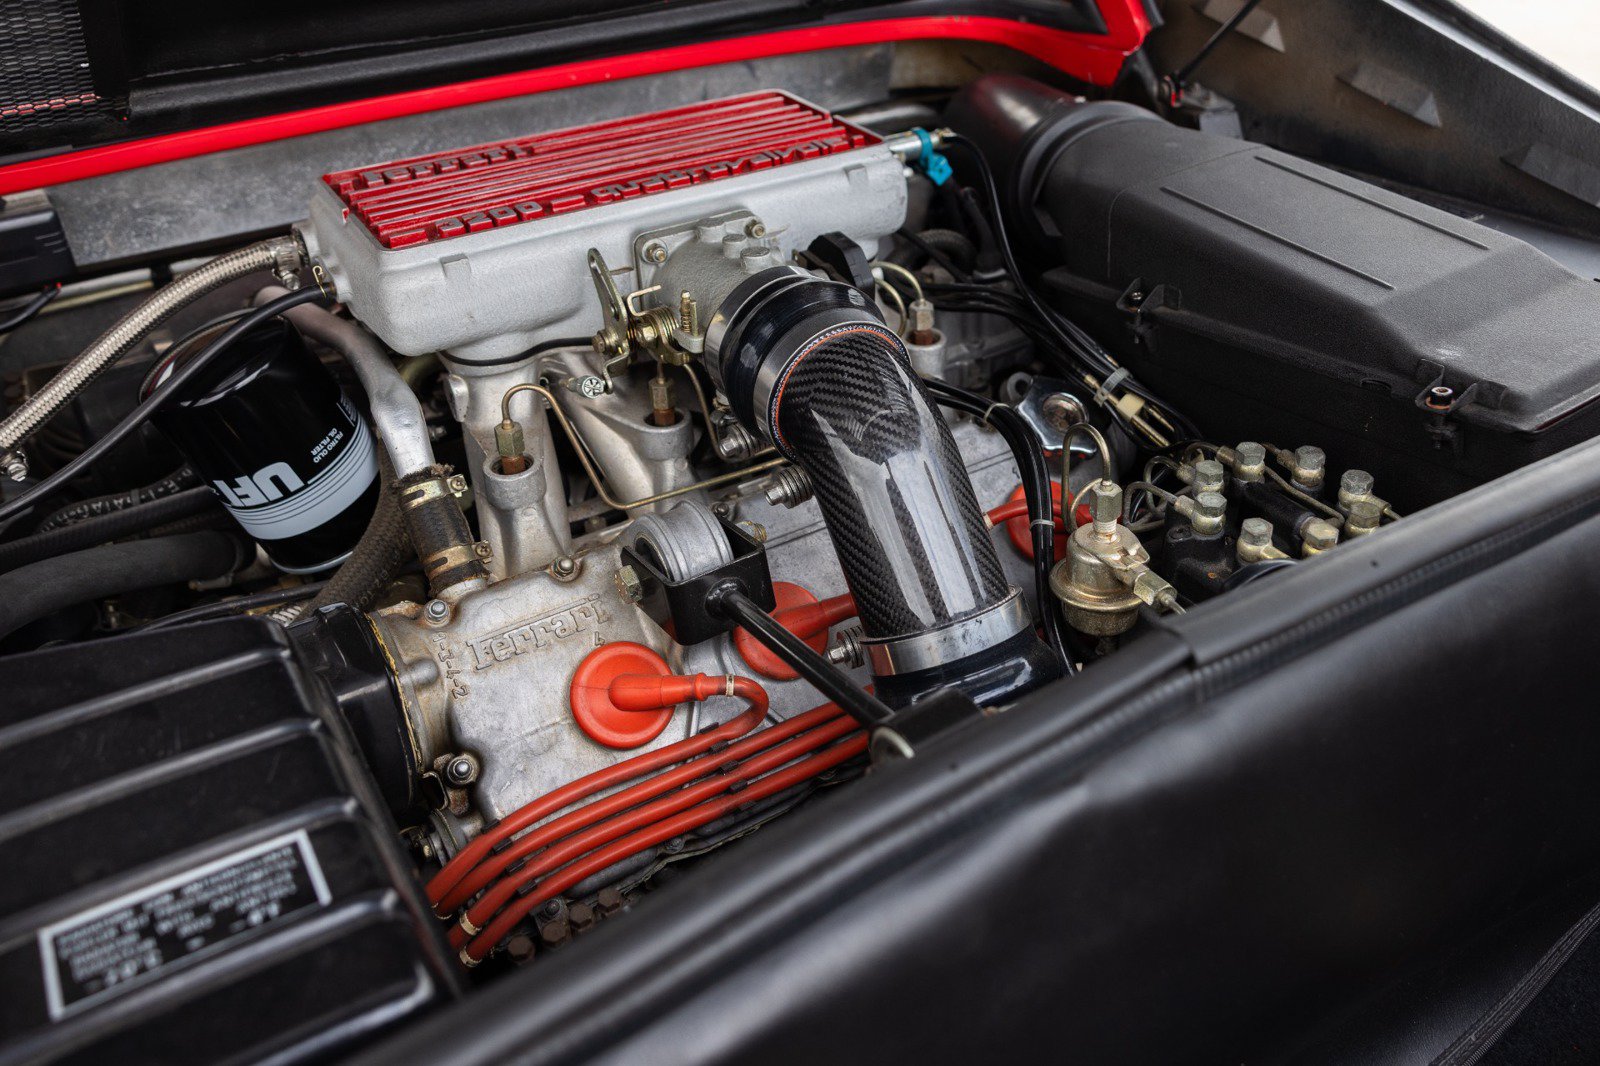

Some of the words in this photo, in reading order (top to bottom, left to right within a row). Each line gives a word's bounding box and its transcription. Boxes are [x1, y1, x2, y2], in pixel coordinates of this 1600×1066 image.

[435, 201, 544, 238] 3200
[327, 431, 344, 450] FILTRO
[328, 428, 338, 438] OIL
[311, 436, 330, 455] FILTER
[313, 449, 328, 463] OLIO
[213, 461, 305, 507] UFI
[465, 593, 608, 670] Ferrari
